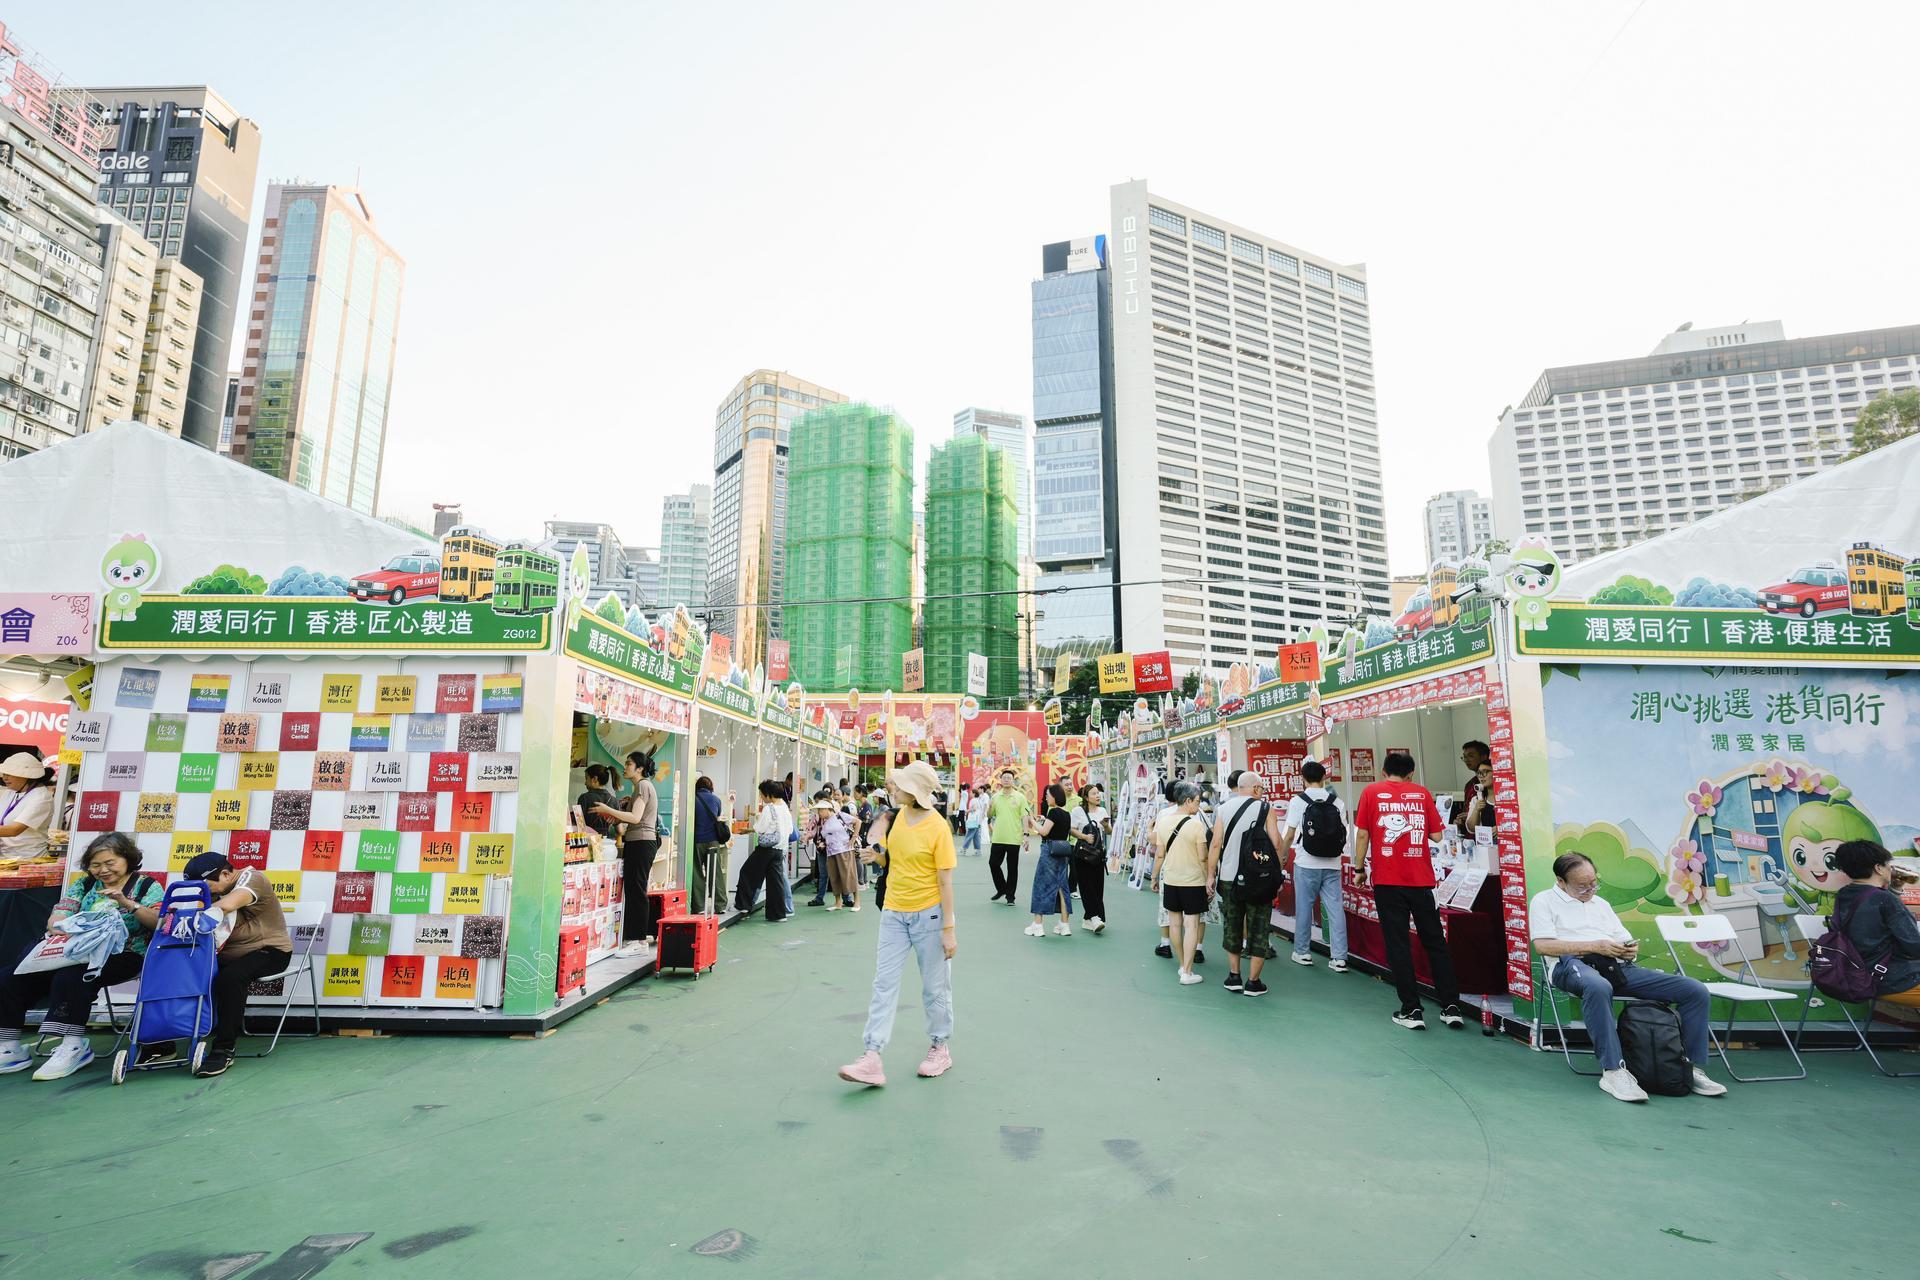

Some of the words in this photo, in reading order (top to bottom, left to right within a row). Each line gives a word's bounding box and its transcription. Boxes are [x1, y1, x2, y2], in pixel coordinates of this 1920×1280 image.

[101, 153, 150, 170] dale
[1123, 216, 1139, 314] CHUBB
[1, 607, 35, 643] 會
[170, 609, 278, 635] 潤愛同行
[305, 610, 473, 635] 香港·匠心製造
[503, 629, 537, 639] ZG012
[1585, 616, 1692, 643] 潤愛同行
[1721, 620, 1892, 647] 香港·便捷生活
[56, 636, 78, 646] Z06
[588, 628, 625, 663] 潤愛同行
[1382, 631, 1455, 672] 香港·便捷生活
[1288, 651, 1312, 665] 天后
[1104, 661, 1126, 675] 油塘
[1141, 662, 1163, 677] 荃灣
[121, 678, 156, 691] 九龍塘
[1114, 676, 1128, 684] Tong
[256, 682, 281, 696] 九龍
[328, 685, 353, 697] 灣仔
[380, 686, 411, 696] 黃大仙
[447, 685, 467, 695] 旺角
[252, 696, 282, 704] Kowloon
[1630, 688, 1754, 724] 潤心挑選
[1766, 684, 1886, 726] 港貨同行
[75, 720, 101, 734] 九龍
[223, 721, 251, 736] 啟德
[291, 723, 310, 734] 中環
[410, 722, 446, 735] 九龍塘
[71, 734, 100, 743] Kowloon
[1711, 733, 1806, 752] 潤愛家居
[181, 764, 214, 776] 炮台山
[243, 763, 275, 773] 黃大仙
[318, 760, 345, 775] 啟德
[375, 762, 401, 775] 九龍
[438, 763, 460, 775] 荃灣
[483, 765, 513, 775] 長沙灣
[89, 803, 109, 813] 中環
[216, 799, 241, 812] 油塘
[349, 804, 376, 814] 長沙灣
[408, 804, 428, 814] 旺角
[459, 801, 484, 814] 天后
[226, 814, 241, 822] Tong
[237, 842, 261, 853] 荃灣
[311, 841, 335, 853] 天后
[362, 842, 395, 854] 炮台山
[426, 842, 452, 855] 北角
[476, 844, 504, 858] 灣仔
[345, 884, 365, 895] 旺角
[395, 884, 429, 896] 炮台山
[450, 886, 478, 896] 調景嶺
[361, 927, 381, 938] 佐敦
[421, 927, 449, 937] 長沙灣
[330, 967, 359, 977] 調景嶺
[391, 966, 416, 979] 天后
[443, 967, 469, 981] 北角
[456, 981, 471, 989] Point
